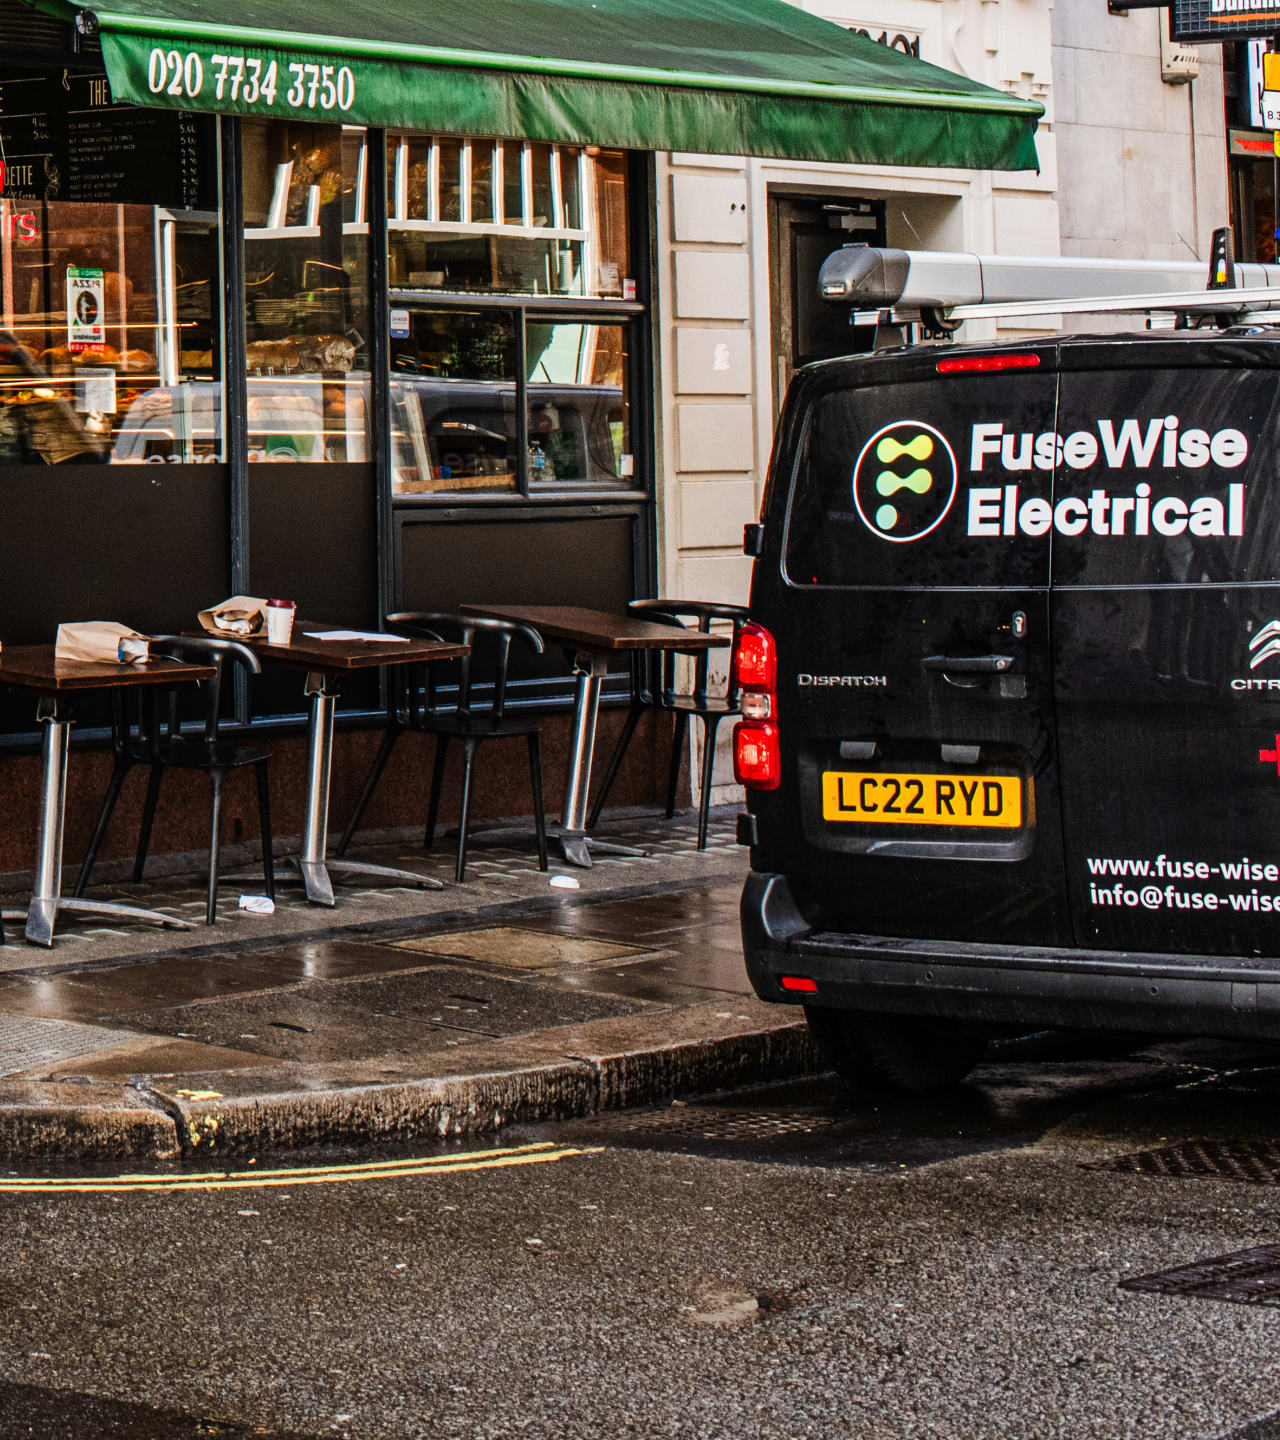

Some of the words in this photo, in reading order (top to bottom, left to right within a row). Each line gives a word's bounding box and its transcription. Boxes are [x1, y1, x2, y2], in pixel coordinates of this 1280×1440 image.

[148, 47, 204, 98] 020
[210, 54, 278, 106] 7734
[287, 62, 356, 111] 3750
[970, 415, 1249, 471] FuseWise
[967, 482, 1244, 537] Electrical
[838, 777, 925, 815] LC22
[936, 780, 1003, 817] RYD
